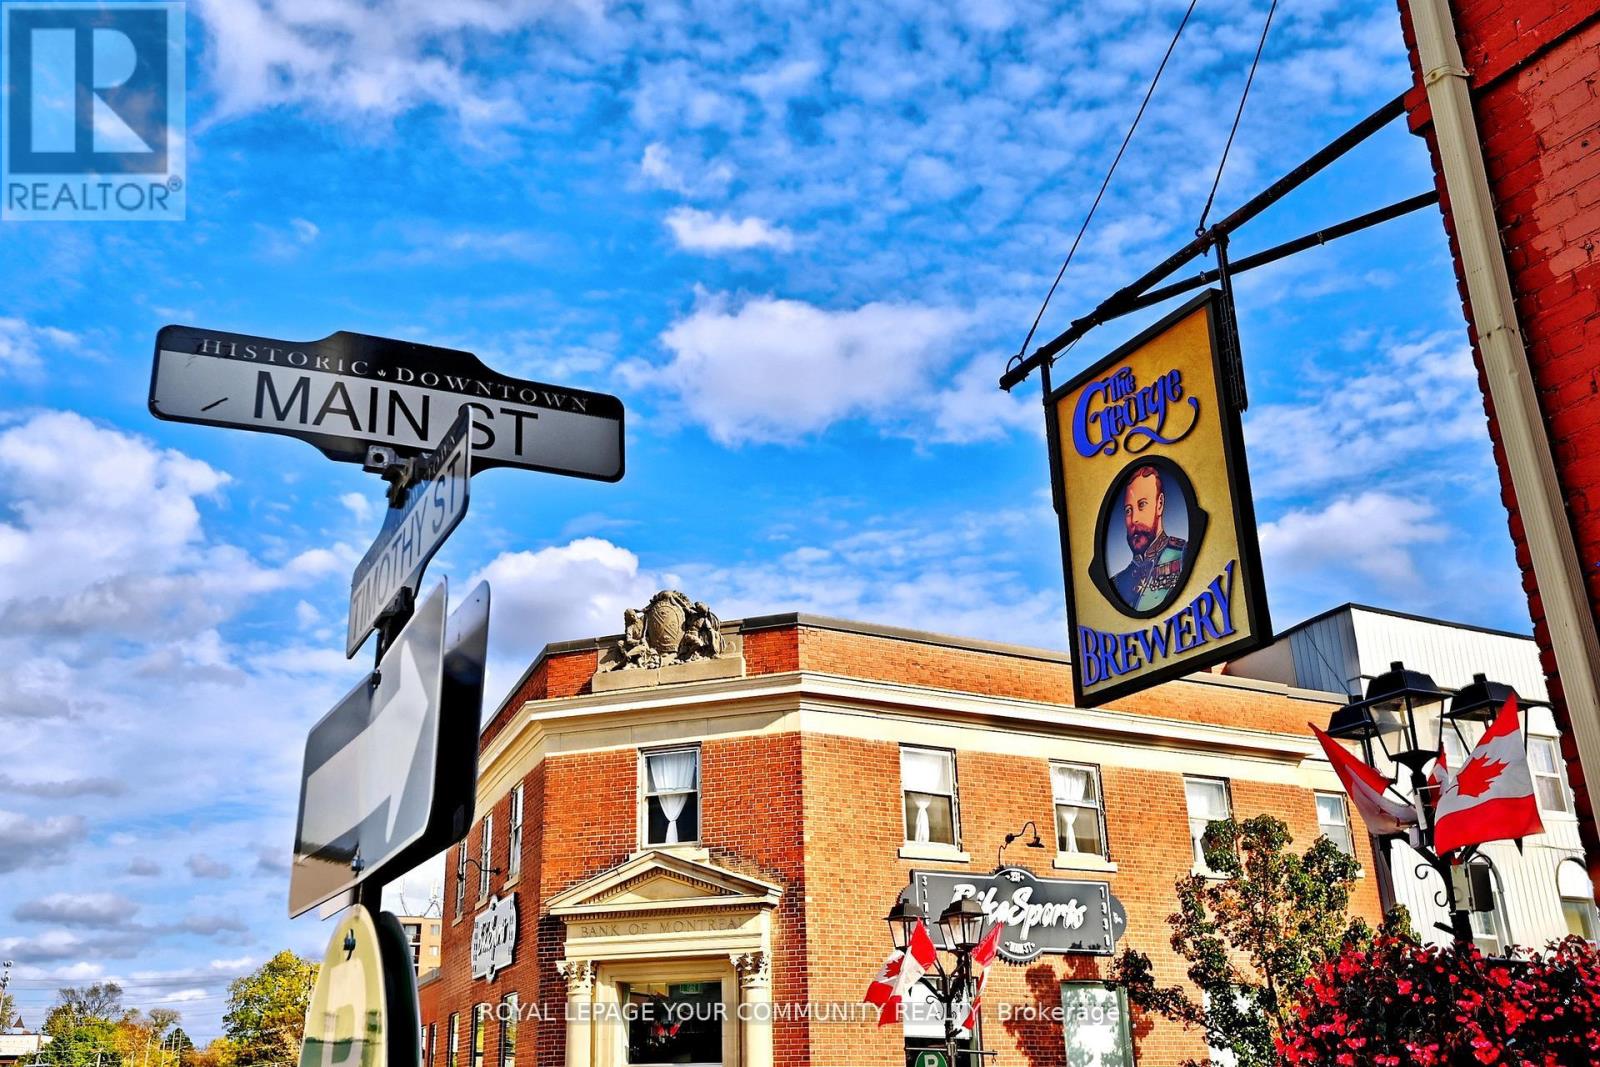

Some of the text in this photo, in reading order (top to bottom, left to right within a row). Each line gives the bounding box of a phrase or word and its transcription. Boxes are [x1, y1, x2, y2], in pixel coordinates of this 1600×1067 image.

[201, 339, 589, 412] HISTORIC DOWNTOWN
[254, 370, 539, 456] MAIN ST
[1072, 368, 1199, 458] George
[1100, 366, 1136, 402] The
[352, 495, 429, 641] TIMOTHY
[432, 450, 462, 535] ST
[1078, 559, 1237, 688] BREWERY
[581, 917, 746, 938] BANK OF MONTREAL
